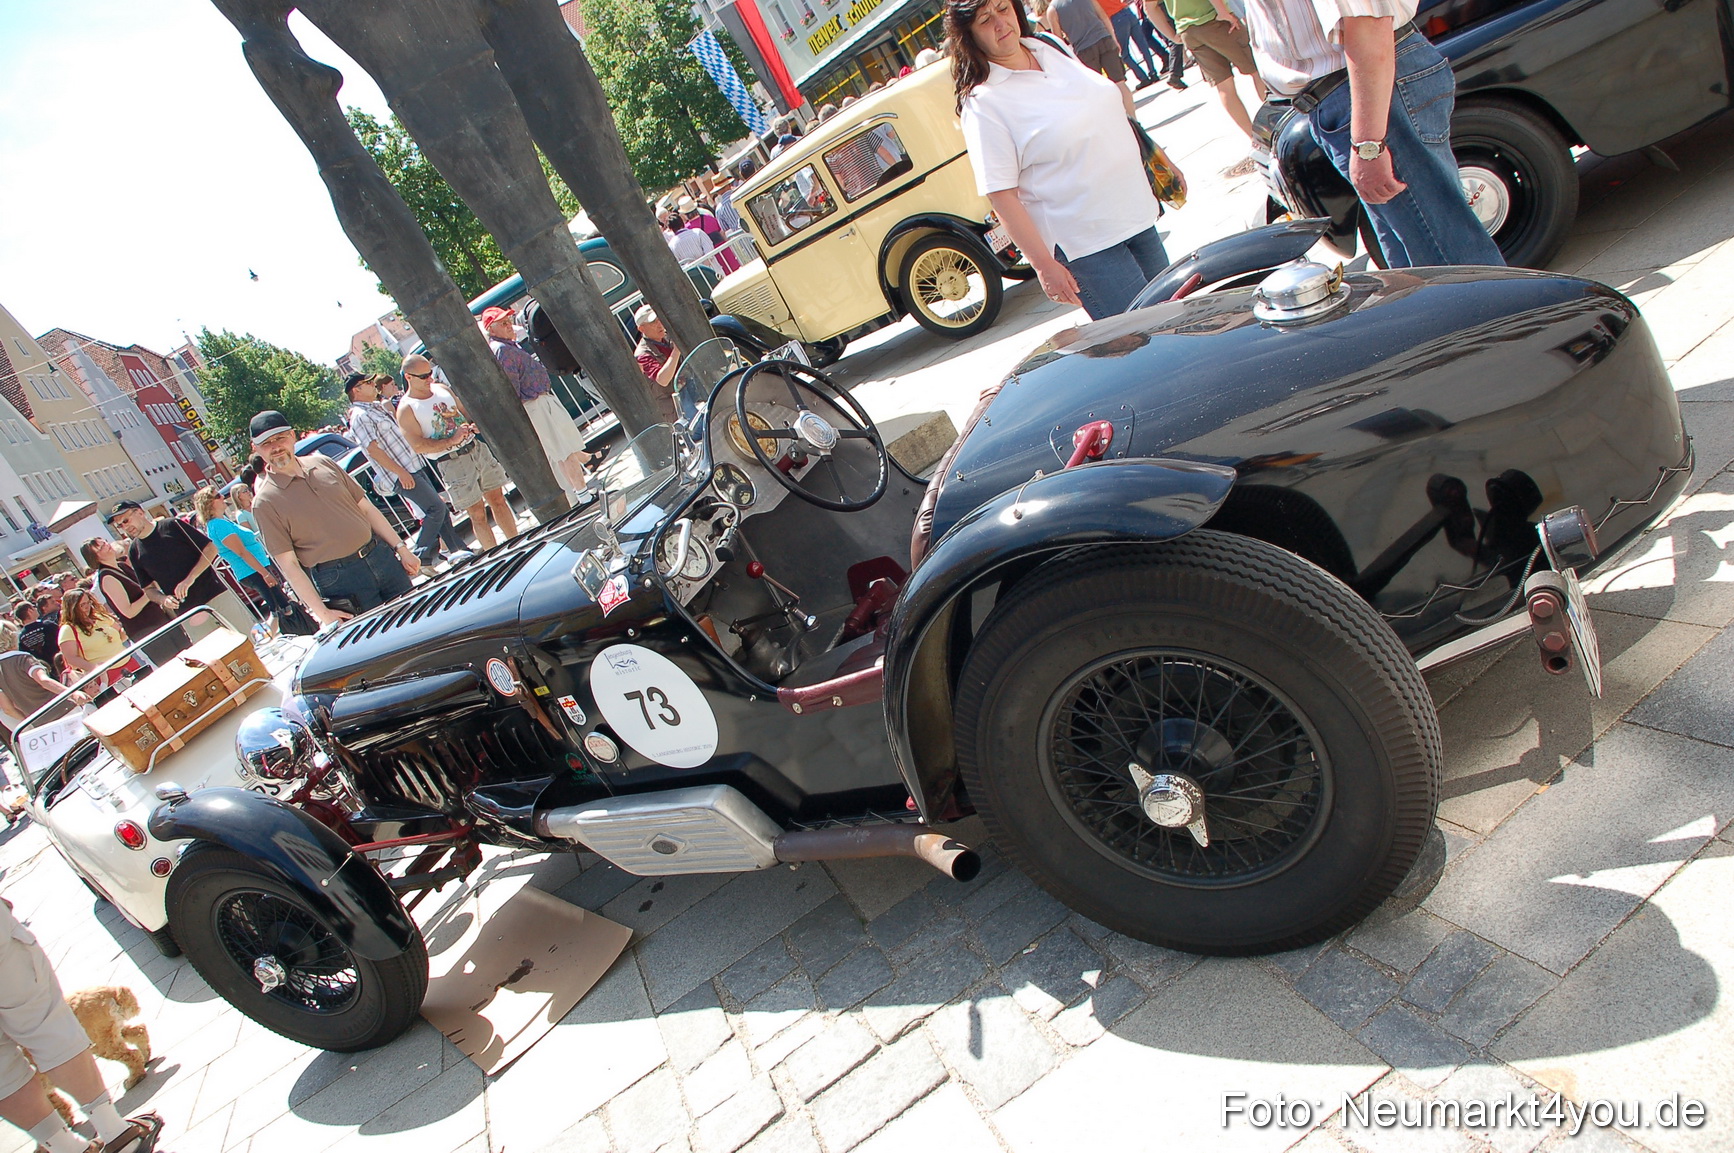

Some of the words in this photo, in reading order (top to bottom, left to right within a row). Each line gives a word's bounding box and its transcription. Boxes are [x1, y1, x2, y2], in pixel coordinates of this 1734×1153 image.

[807, 14, 846, 56] mayer
[178, 399, 218, 451] HOTEL
[623, 686, 681, 730] 73
